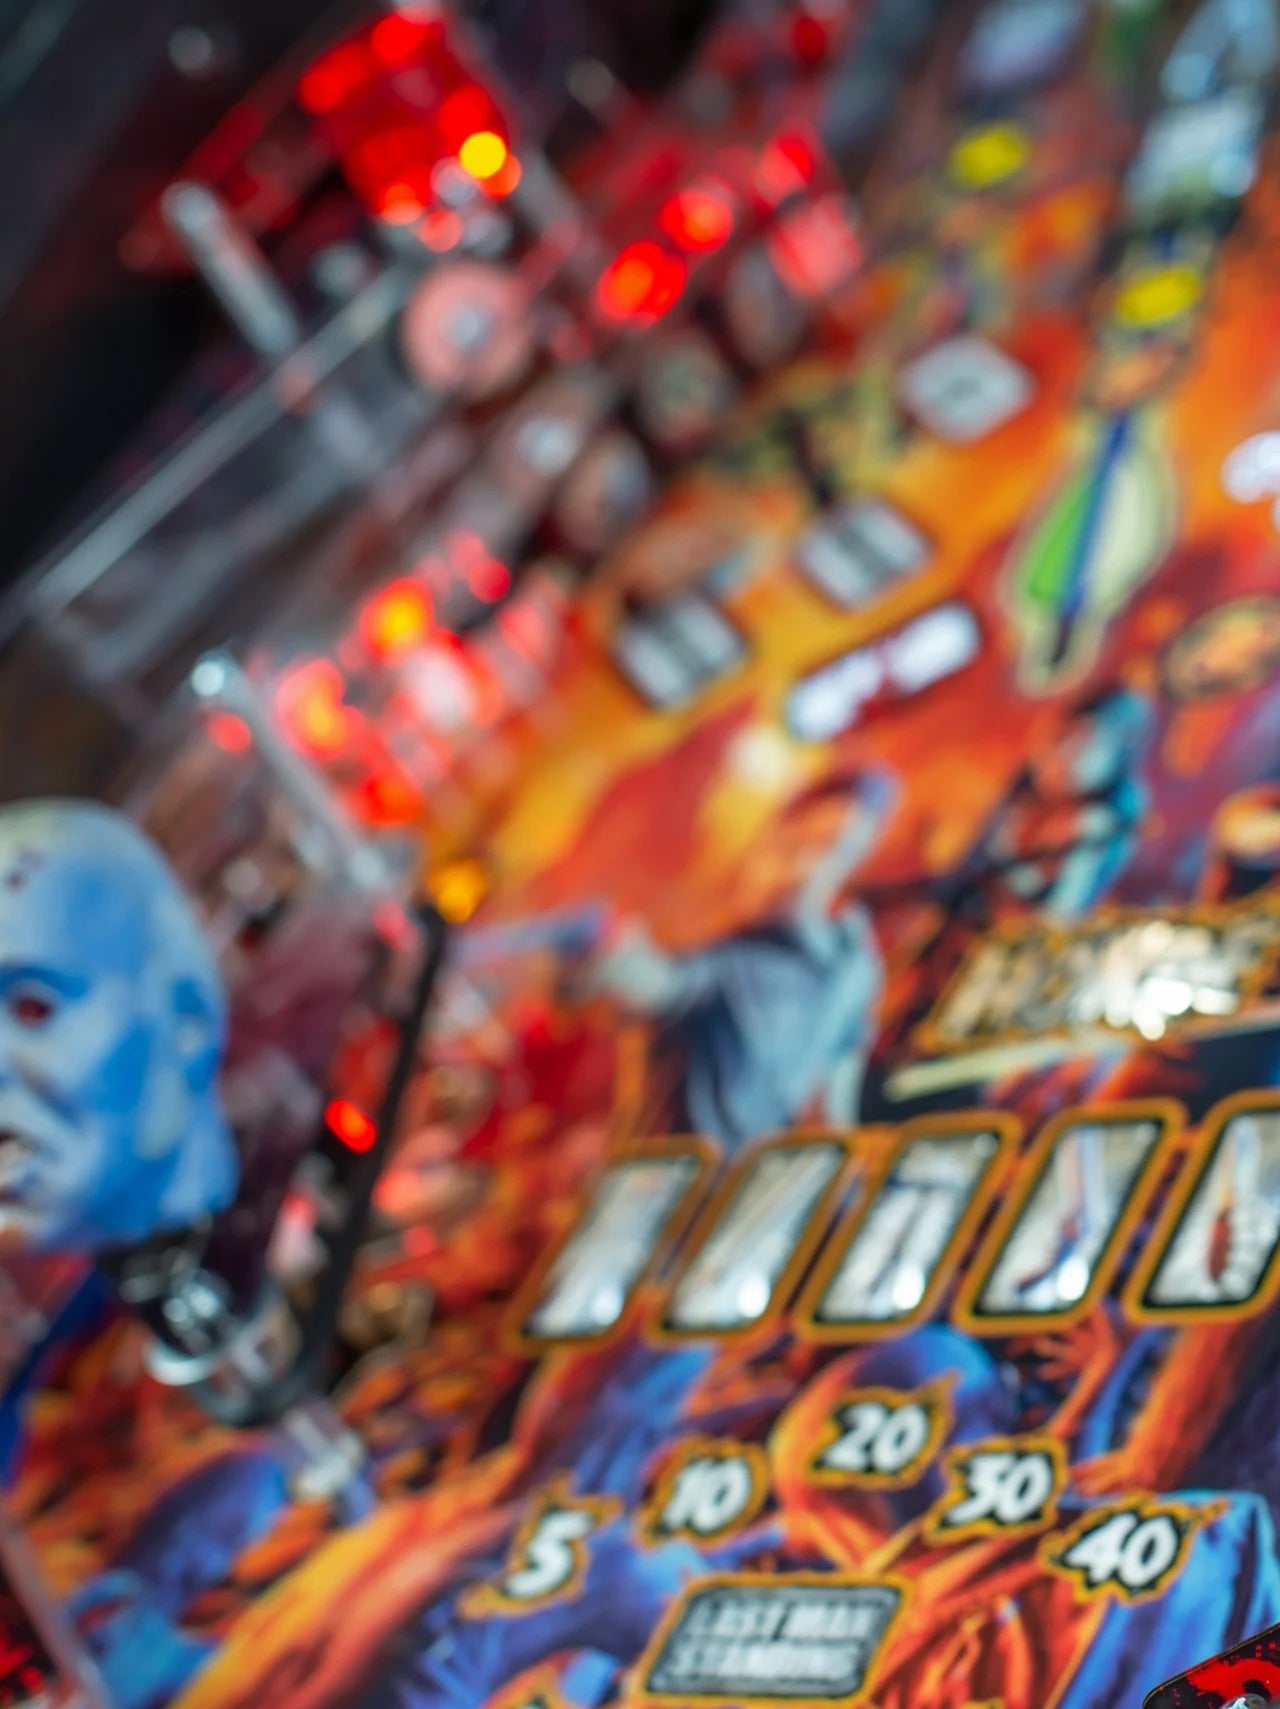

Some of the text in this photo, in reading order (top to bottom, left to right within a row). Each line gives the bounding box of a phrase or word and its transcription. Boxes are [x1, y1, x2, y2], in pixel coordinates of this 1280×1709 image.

[821, 1401, 928, 1472] 20
[662, 1456, 752, 1532] 10
[506, 1508, 592, 1598] 5
[1065, 1511, 1178, 1587] 40
